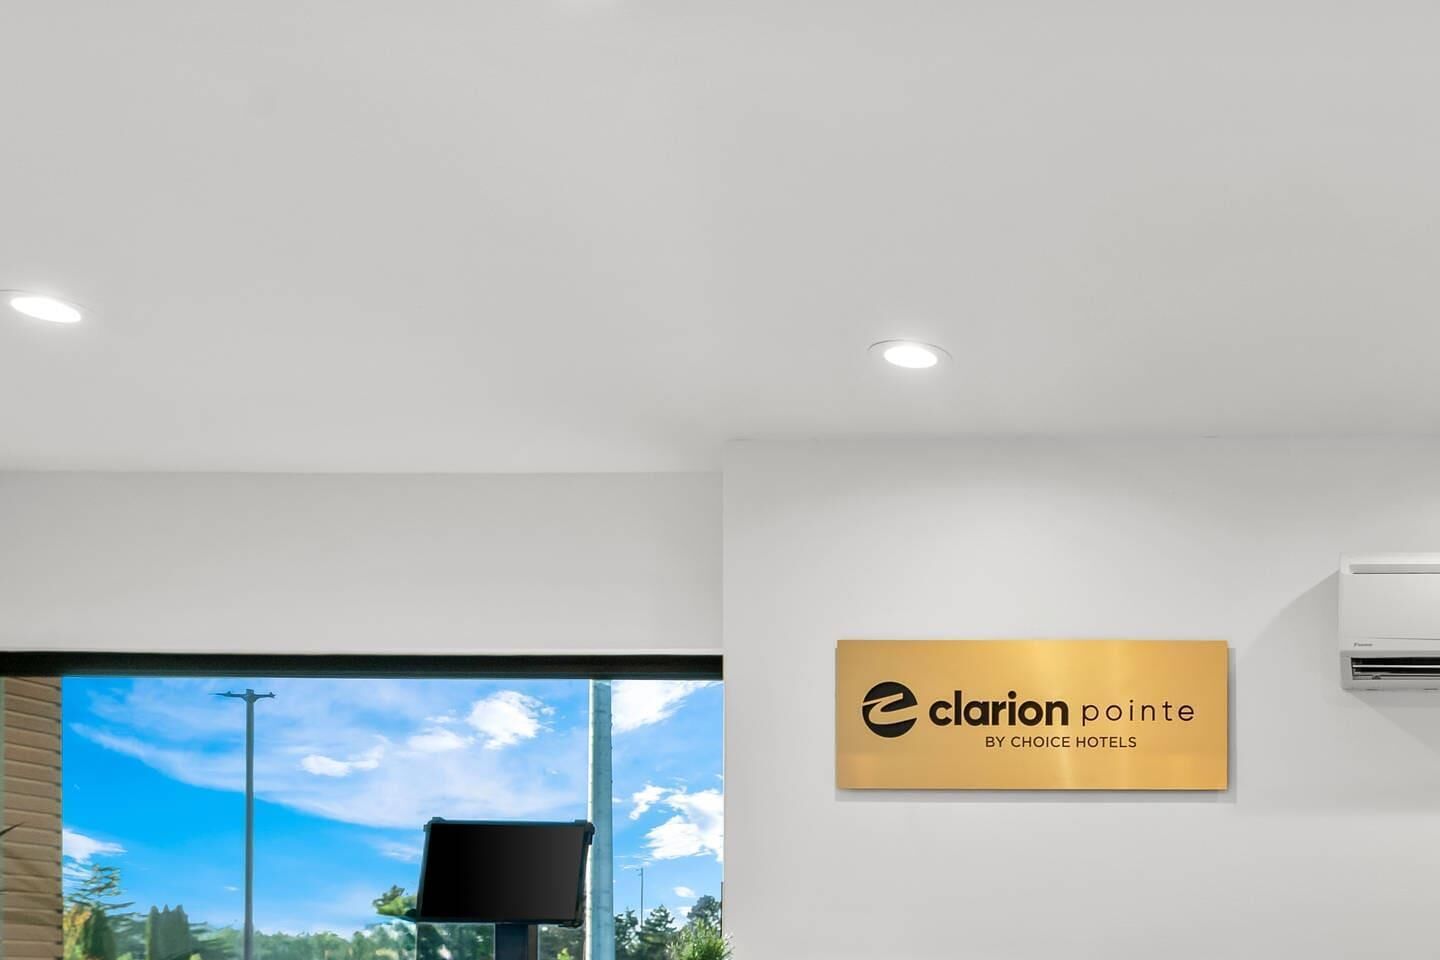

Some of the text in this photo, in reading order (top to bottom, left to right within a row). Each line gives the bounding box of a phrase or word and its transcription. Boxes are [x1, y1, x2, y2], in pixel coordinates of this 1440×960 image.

[928, 689, 1195, 727] clarion pointe
[985, 735, 1137, 748] BY CHOICE HOTELS
